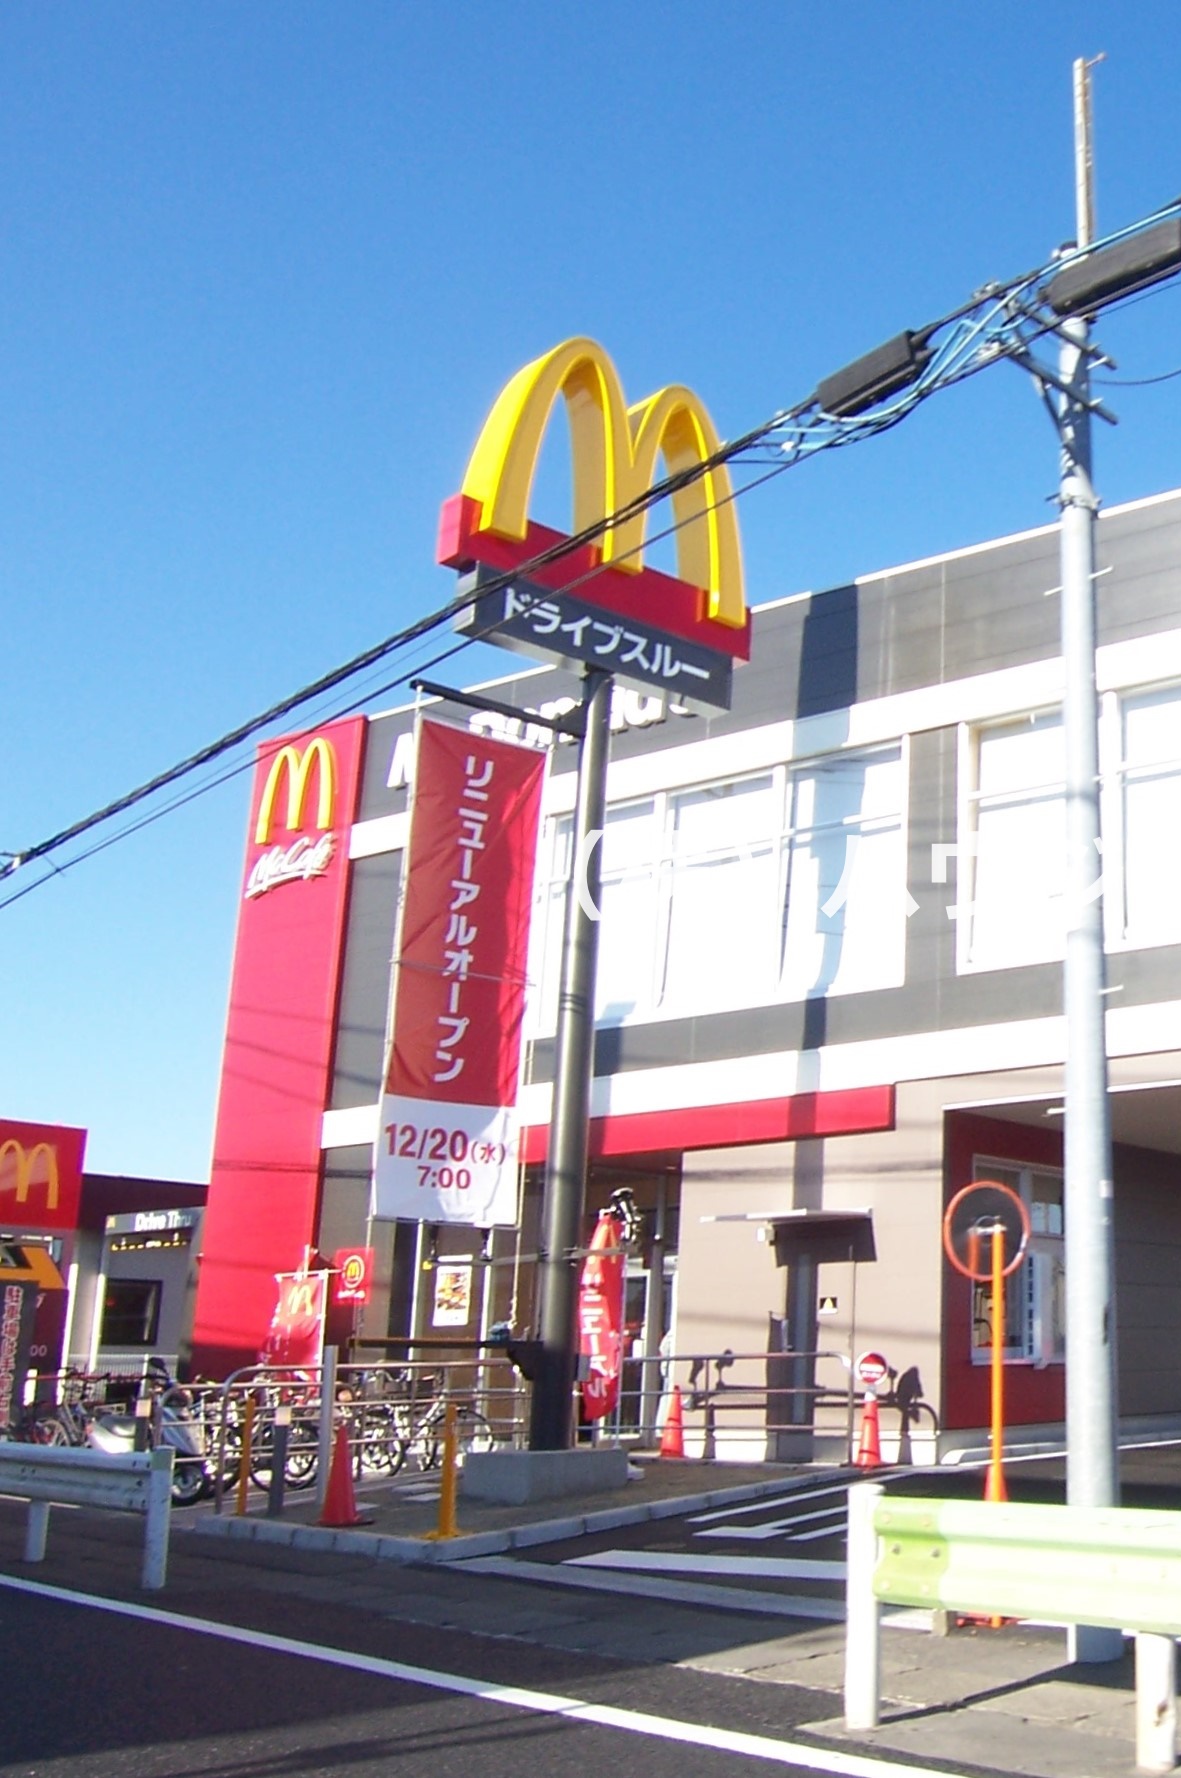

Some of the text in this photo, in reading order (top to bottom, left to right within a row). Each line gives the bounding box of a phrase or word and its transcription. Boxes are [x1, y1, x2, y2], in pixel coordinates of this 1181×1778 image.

[504, 587, 710, 679] ドライブスルー
[433, 755, 494, 1082] リニューアルオープン
[417, 1165, 471, 1190] 7:00
[134, 1210, 192, 1232] Drive Thru
